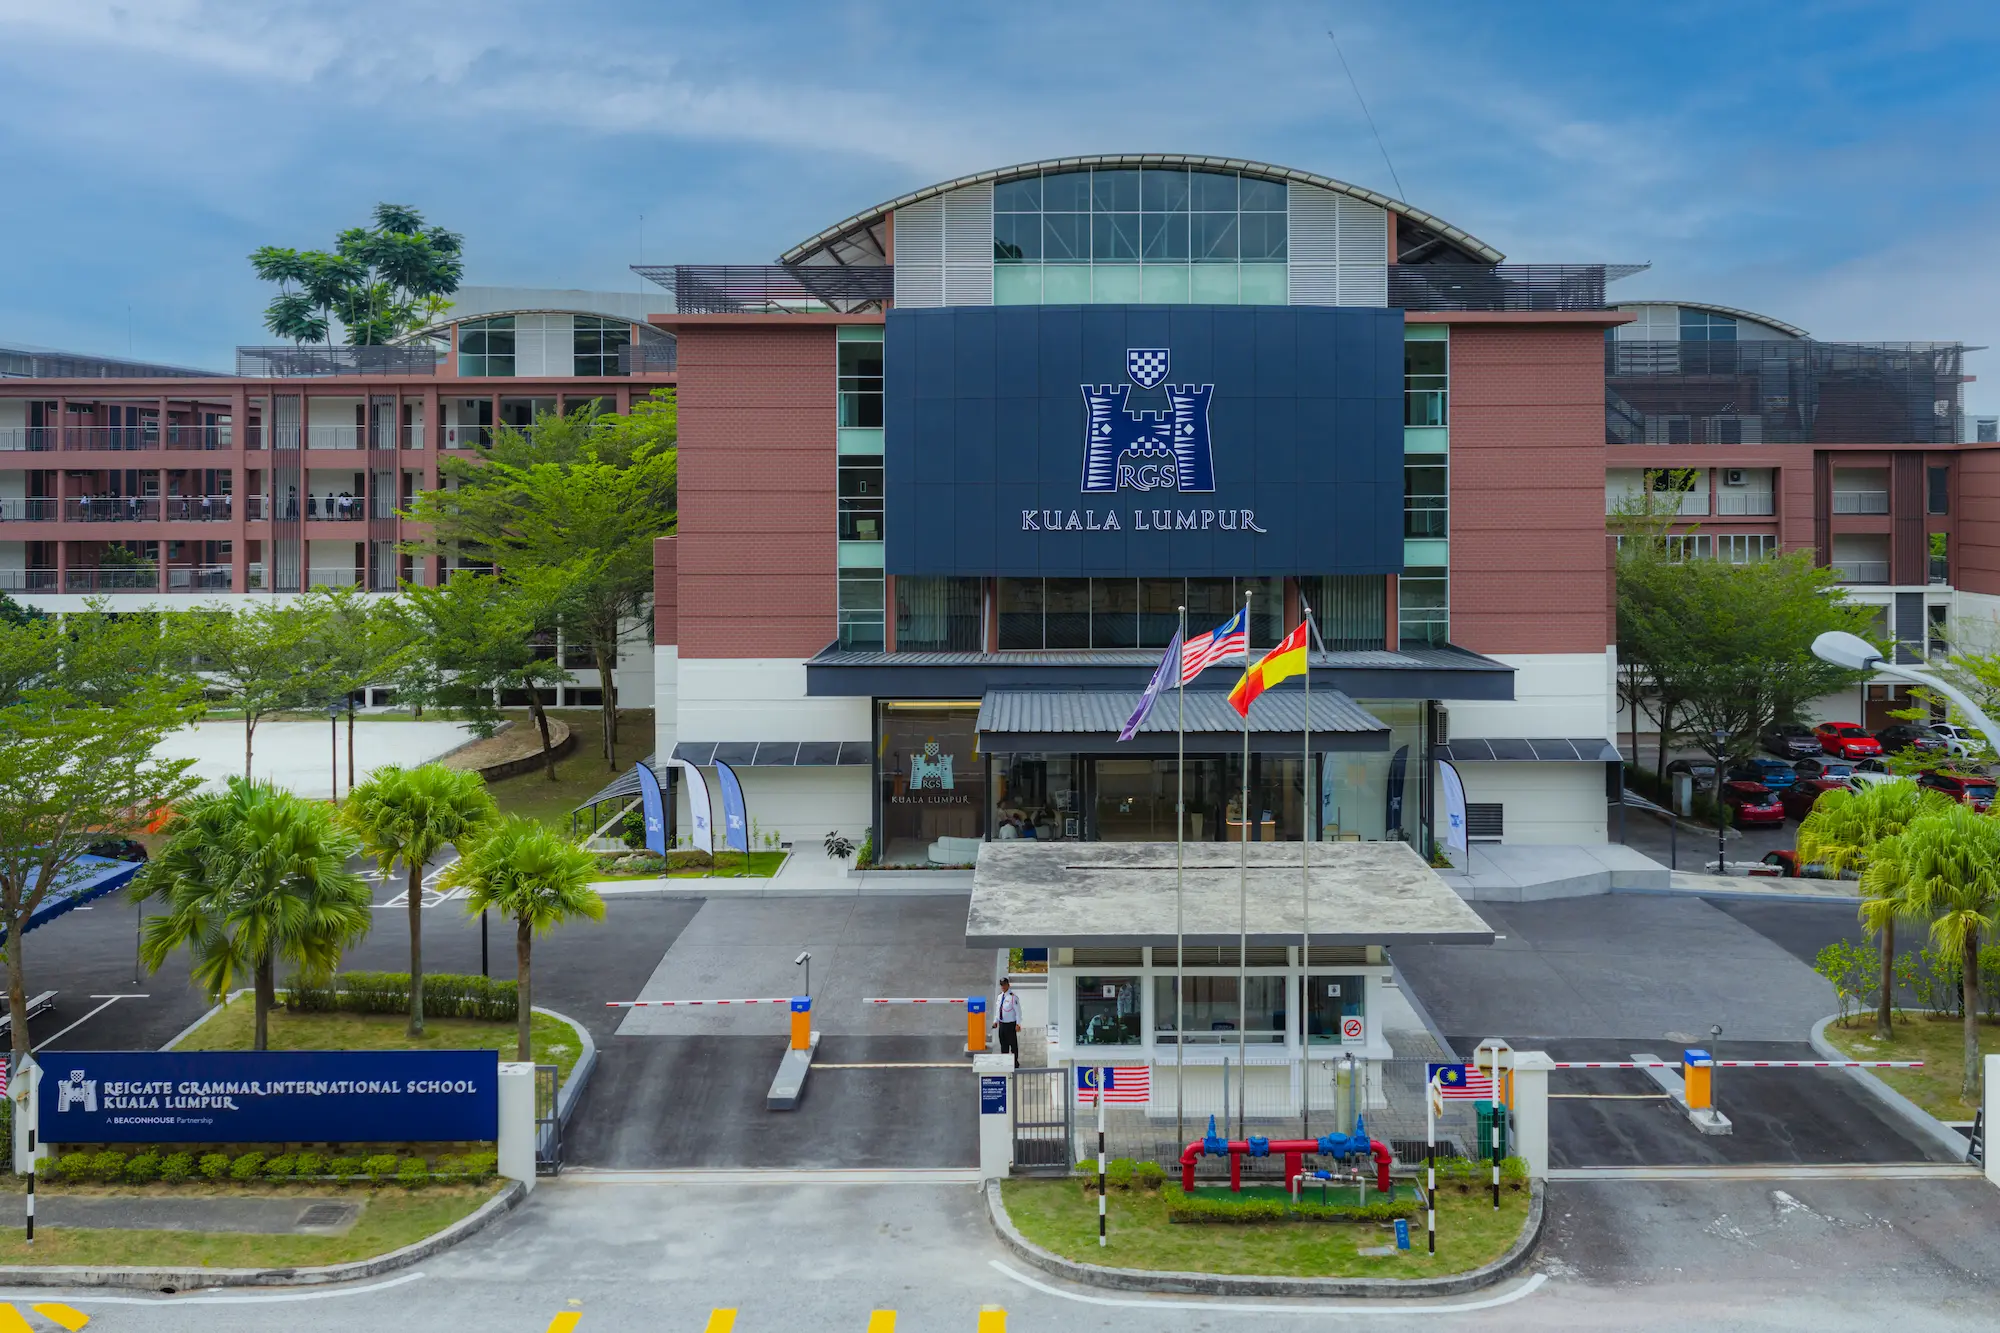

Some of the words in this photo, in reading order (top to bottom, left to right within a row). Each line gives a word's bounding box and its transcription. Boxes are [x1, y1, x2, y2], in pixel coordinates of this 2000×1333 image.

[1119, 464, 1176, 491] RGS
[1021, 509, 1121, 531] KUALA
[1134, 509, 1267, 533] LUMPUR
[922, 780, 941, 789] RGS
[891, 796, 924, 804] KUALA
[928, 796, 970, 804] LUMPUR
[103, 1081, 173, 1096] REIGATE
[177, 1081, 267, 1096] GRAMMAR
[266, 1080, 401, 1096] INTERNATIONAL
[406, 1080, 477, 1094] SCHOOL
[103, 1096, 160, 1109] KUALA
[165, 1096, 240, 1110] LUMPUR
[176, 1117, 214, 1125] Partnership
